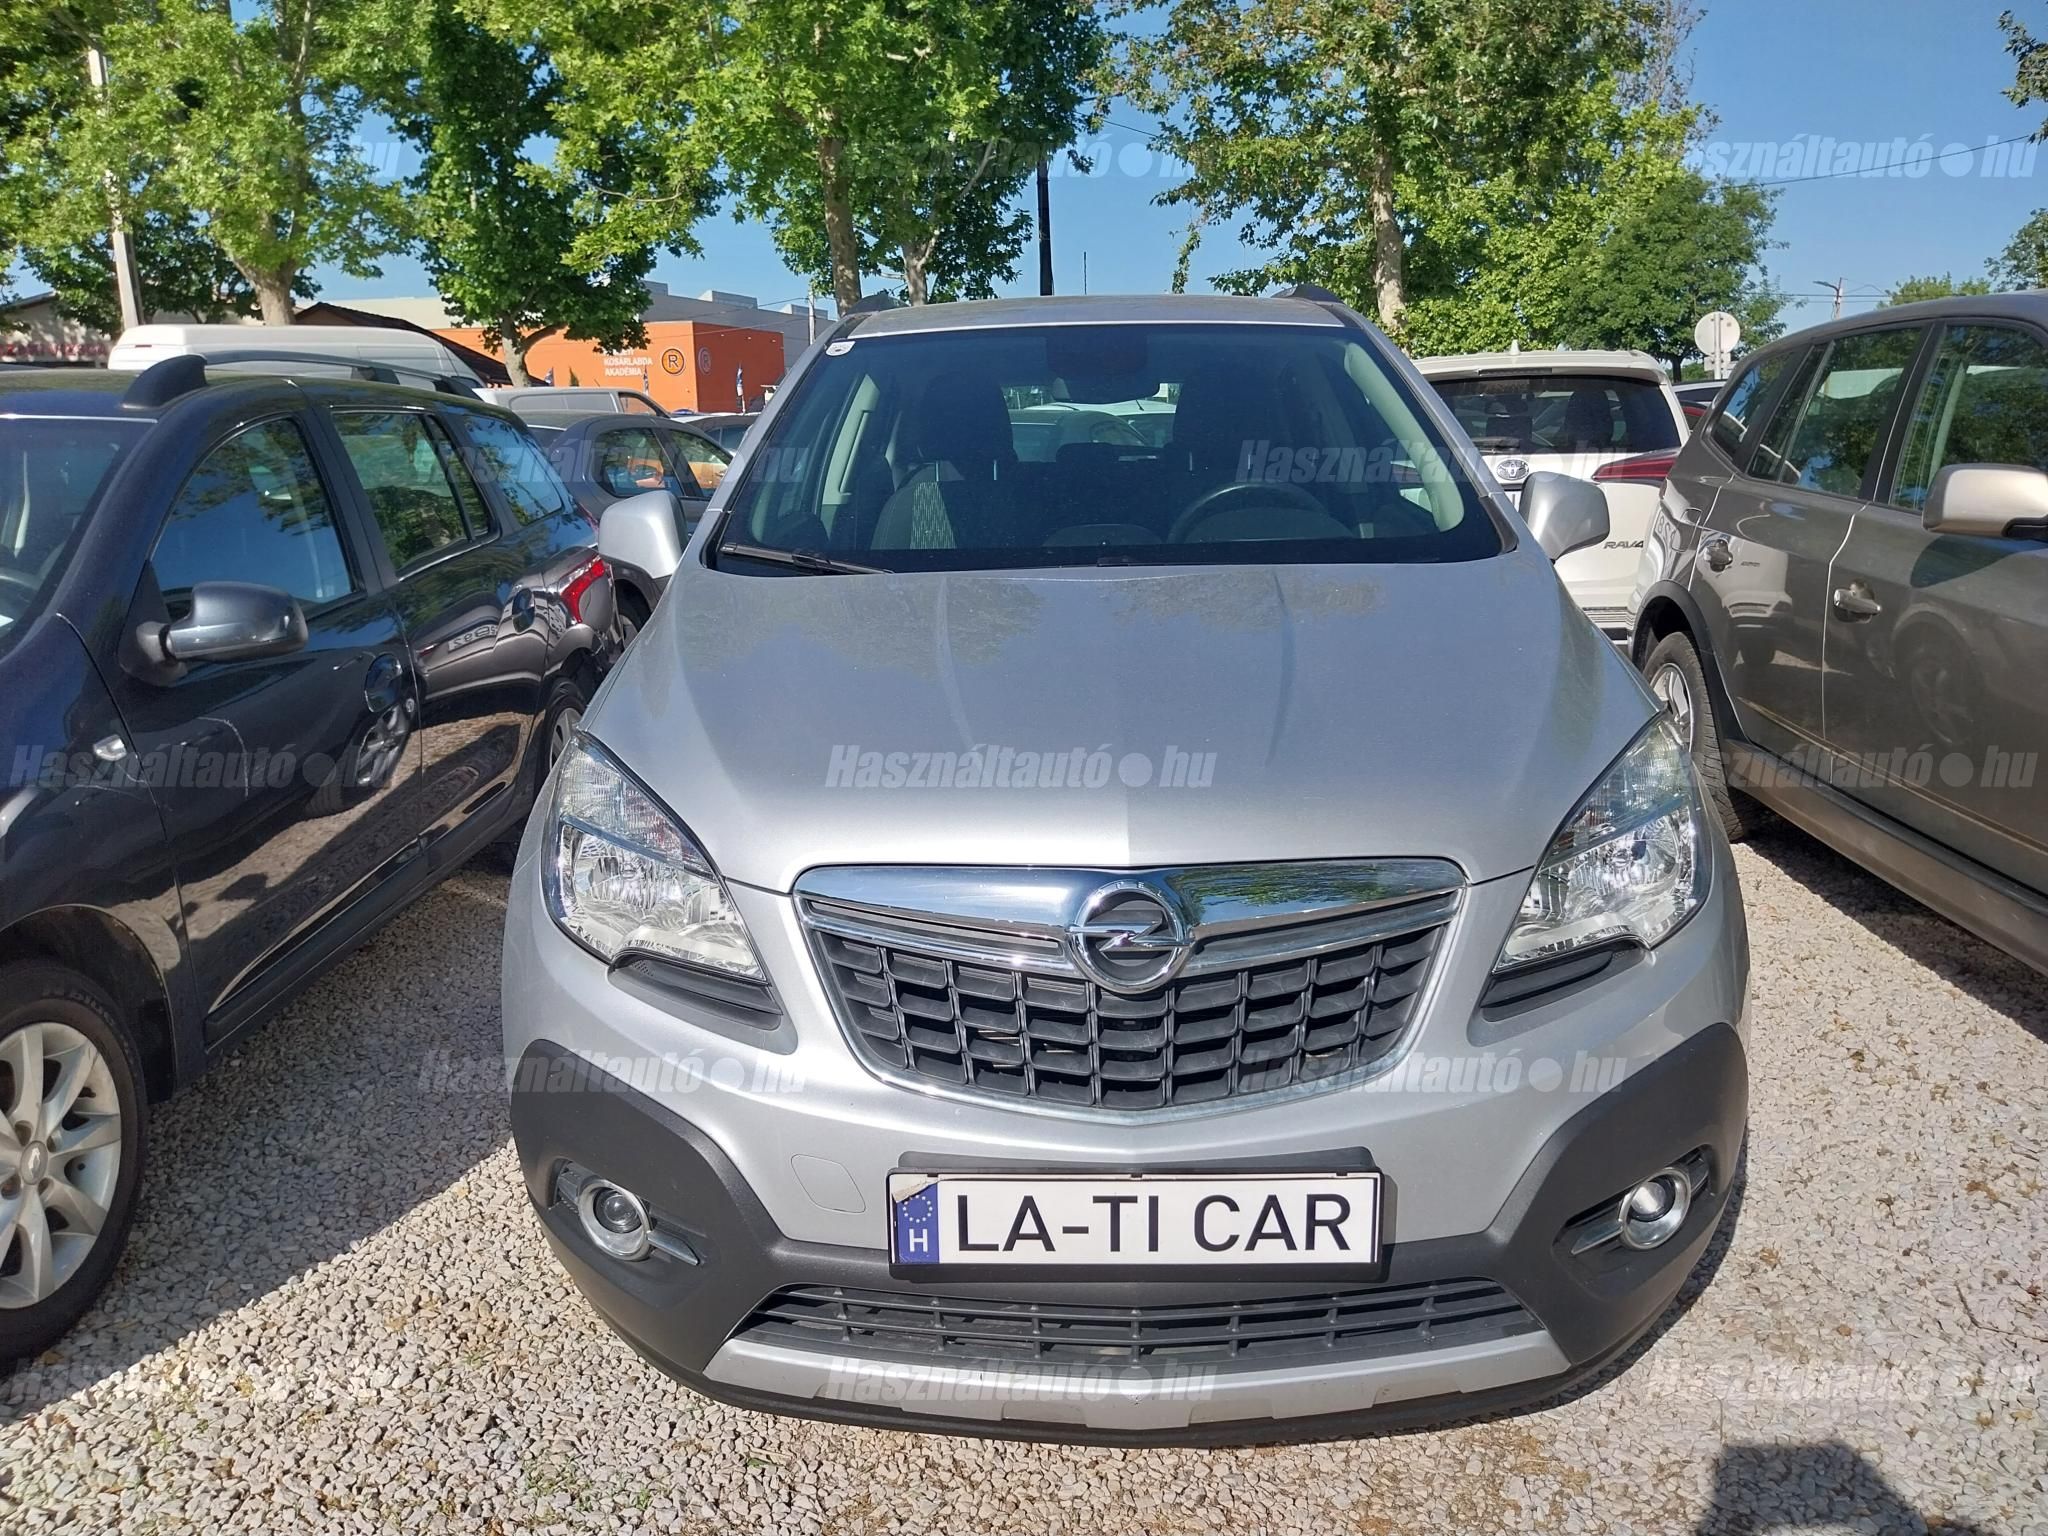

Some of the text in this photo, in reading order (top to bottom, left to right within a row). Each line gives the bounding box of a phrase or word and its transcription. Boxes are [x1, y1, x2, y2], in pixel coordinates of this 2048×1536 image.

[1603, 539, 1644, 549] RAV4
[957, 1193, 1351, 1252] LA-TI CAR
[908, 1228, 928, 1253] H
